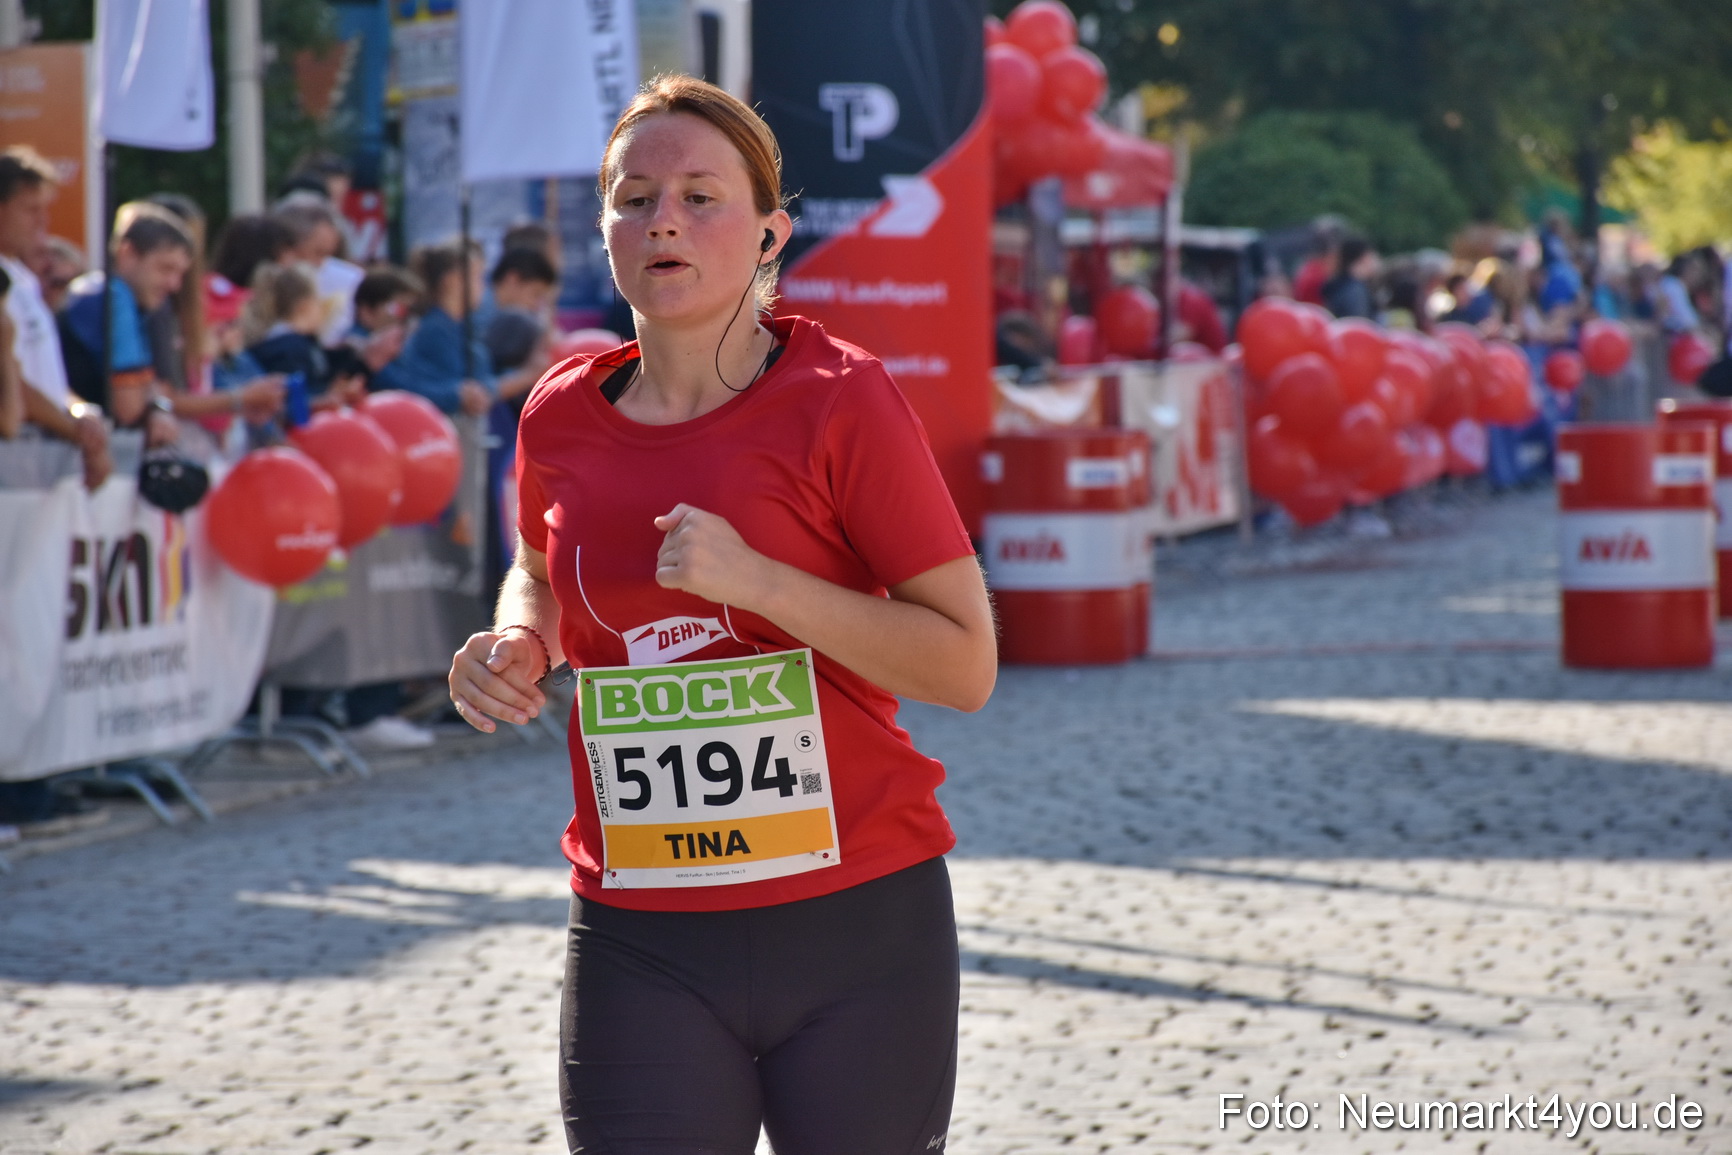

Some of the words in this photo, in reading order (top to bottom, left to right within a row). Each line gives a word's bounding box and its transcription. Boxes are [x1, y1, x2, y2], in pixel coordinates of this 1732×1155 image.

[658, 621, 706, 651] DEHN
[596, 663, 795, 726] BOCK
[800, 735, 811, 748] S
[613, 735, 798, 811] 5194
[664, 829, 752, 859] TINA
